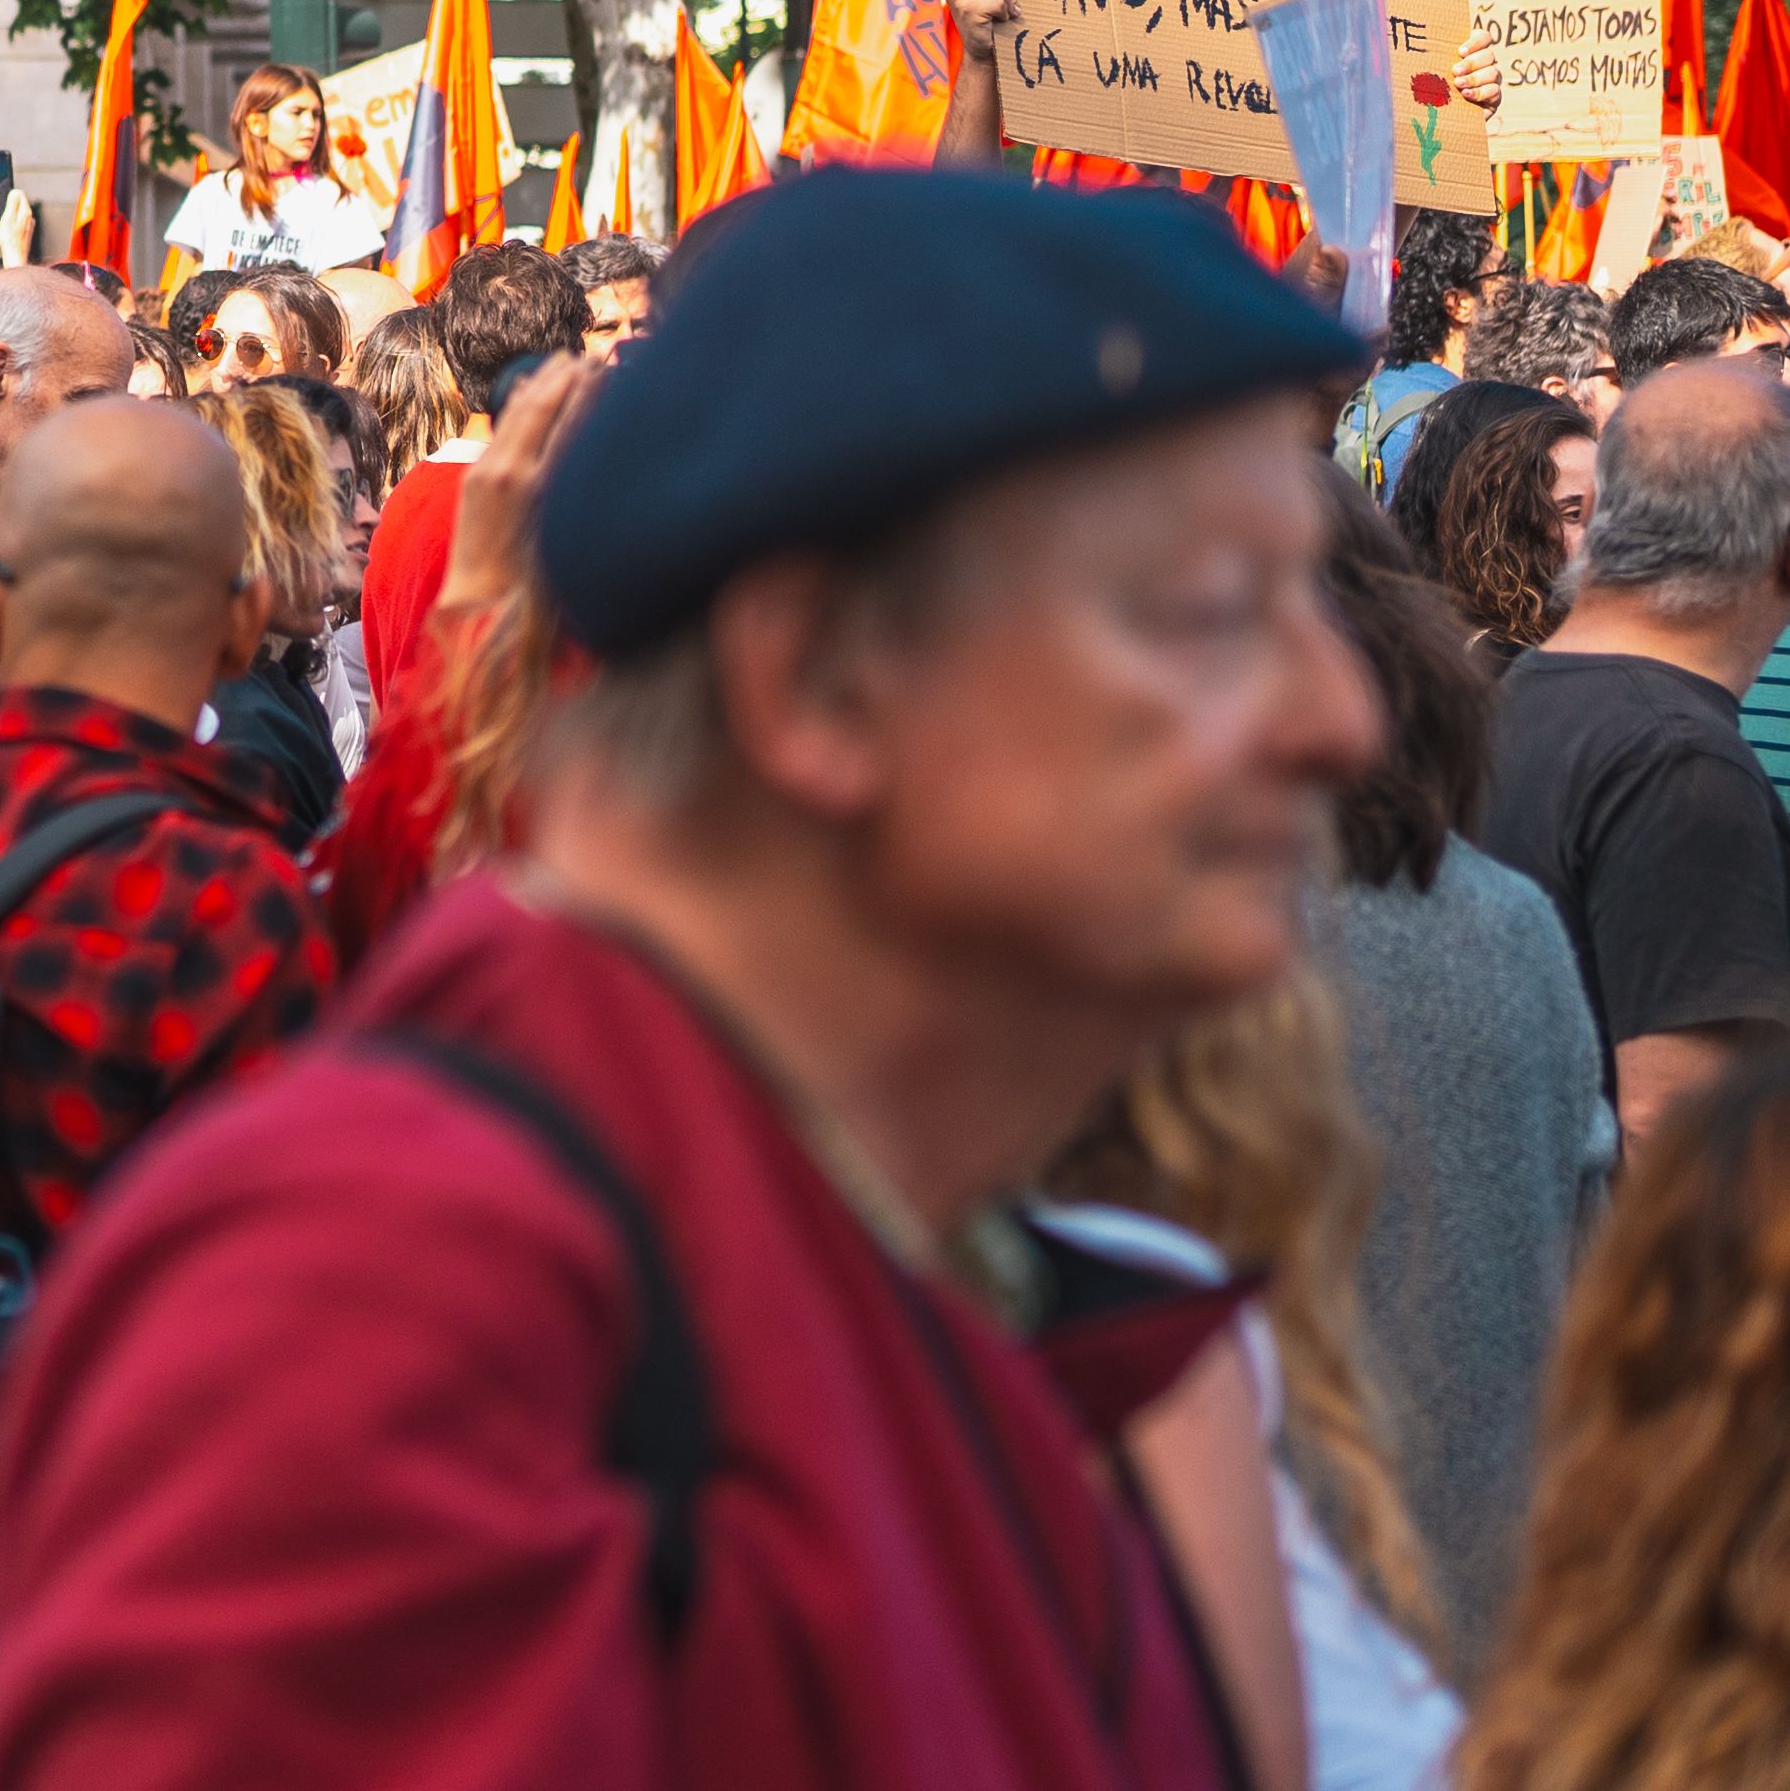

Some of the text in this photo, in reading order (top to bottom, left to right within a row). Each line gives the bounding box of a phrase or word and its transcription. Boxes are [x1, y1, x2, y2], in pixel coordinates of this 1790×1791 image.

[1472, 3, 1503, 45] ÃO
[1505, 5, 1589, 47] ESTAMOS
[1592, 5, 1657, 44] TODAS
[1014, 28, 1065, 89] CÁ
[1092, 50, 1161, 92] UMA
[1186, 59, 1279, 115] REVOL
[1507, 57, 1580, 88] SOMOS
